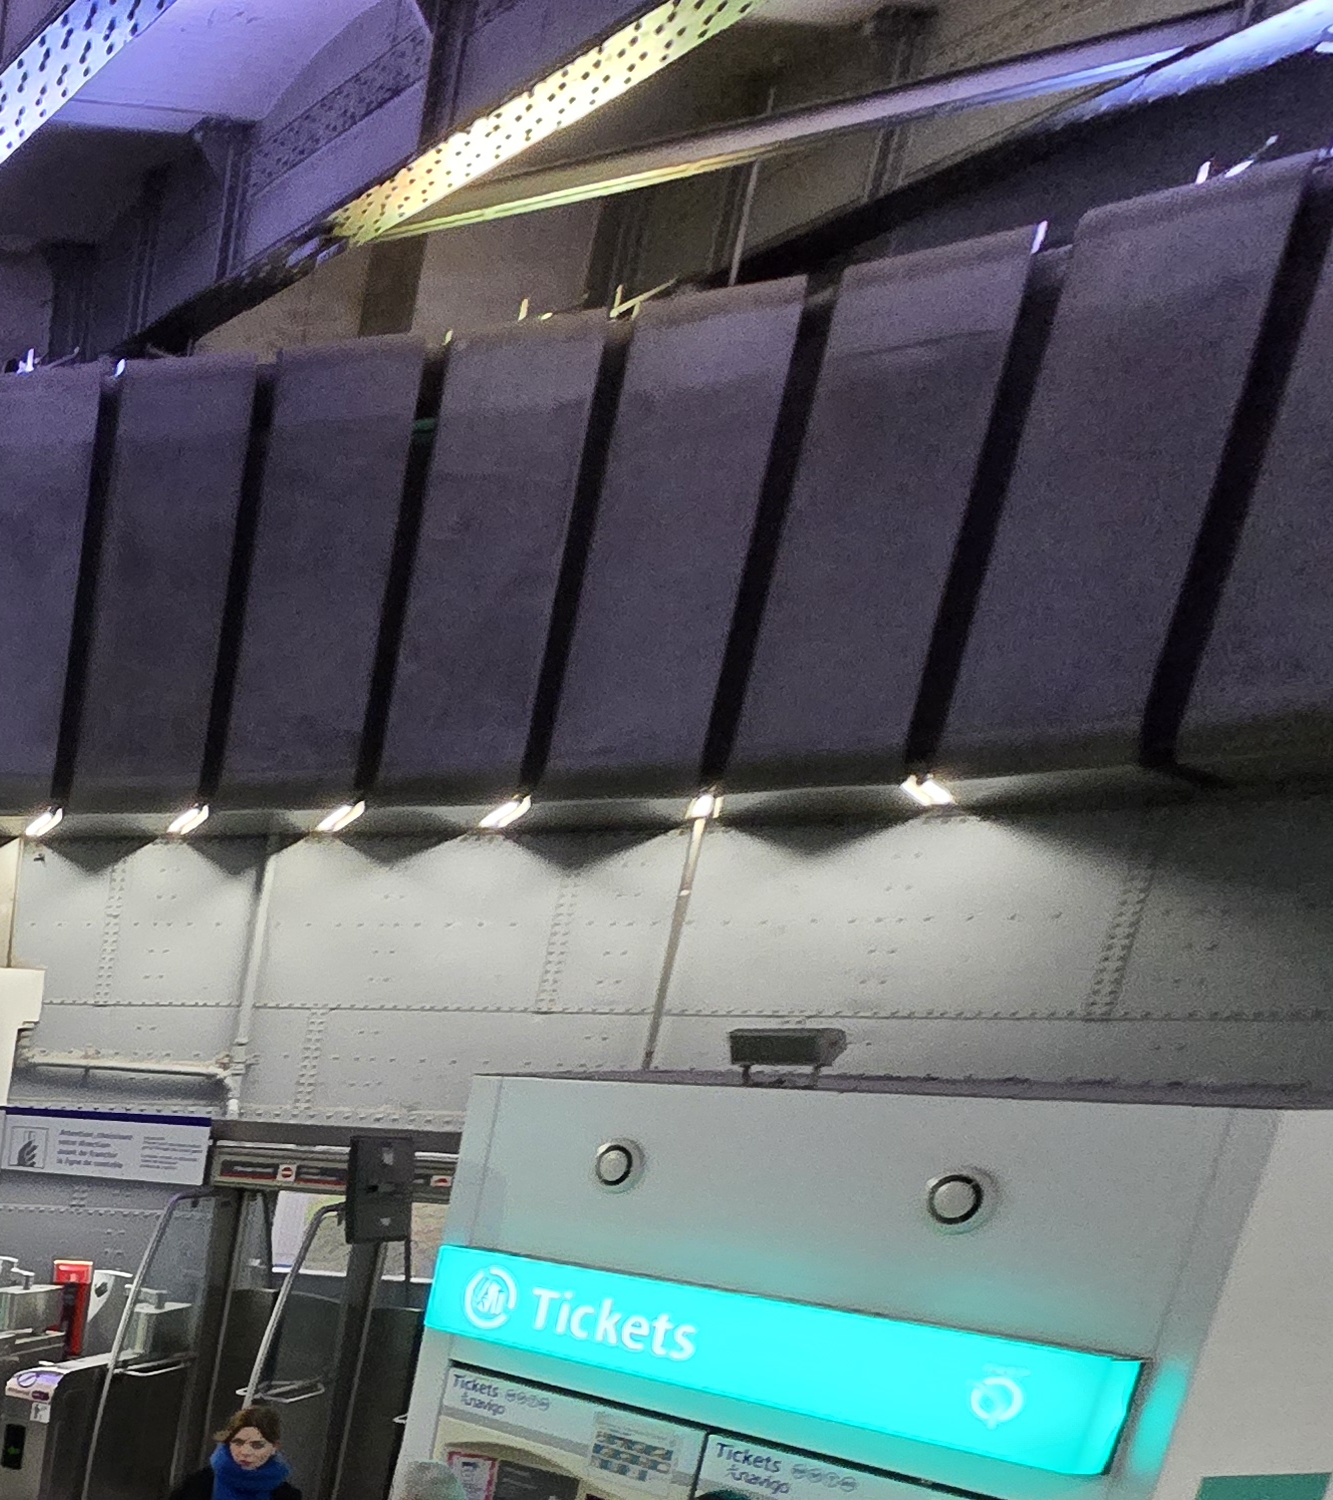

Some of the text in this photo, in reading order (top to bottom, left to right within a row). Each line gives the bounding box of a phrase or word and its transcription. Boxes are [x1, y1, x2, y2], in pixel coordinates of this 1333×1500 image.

[532, 1286, 698, 1361] Tickets
[453, 1373, 500, 1398] Tickets
[715, 1441, 784, 1475] Tickets
